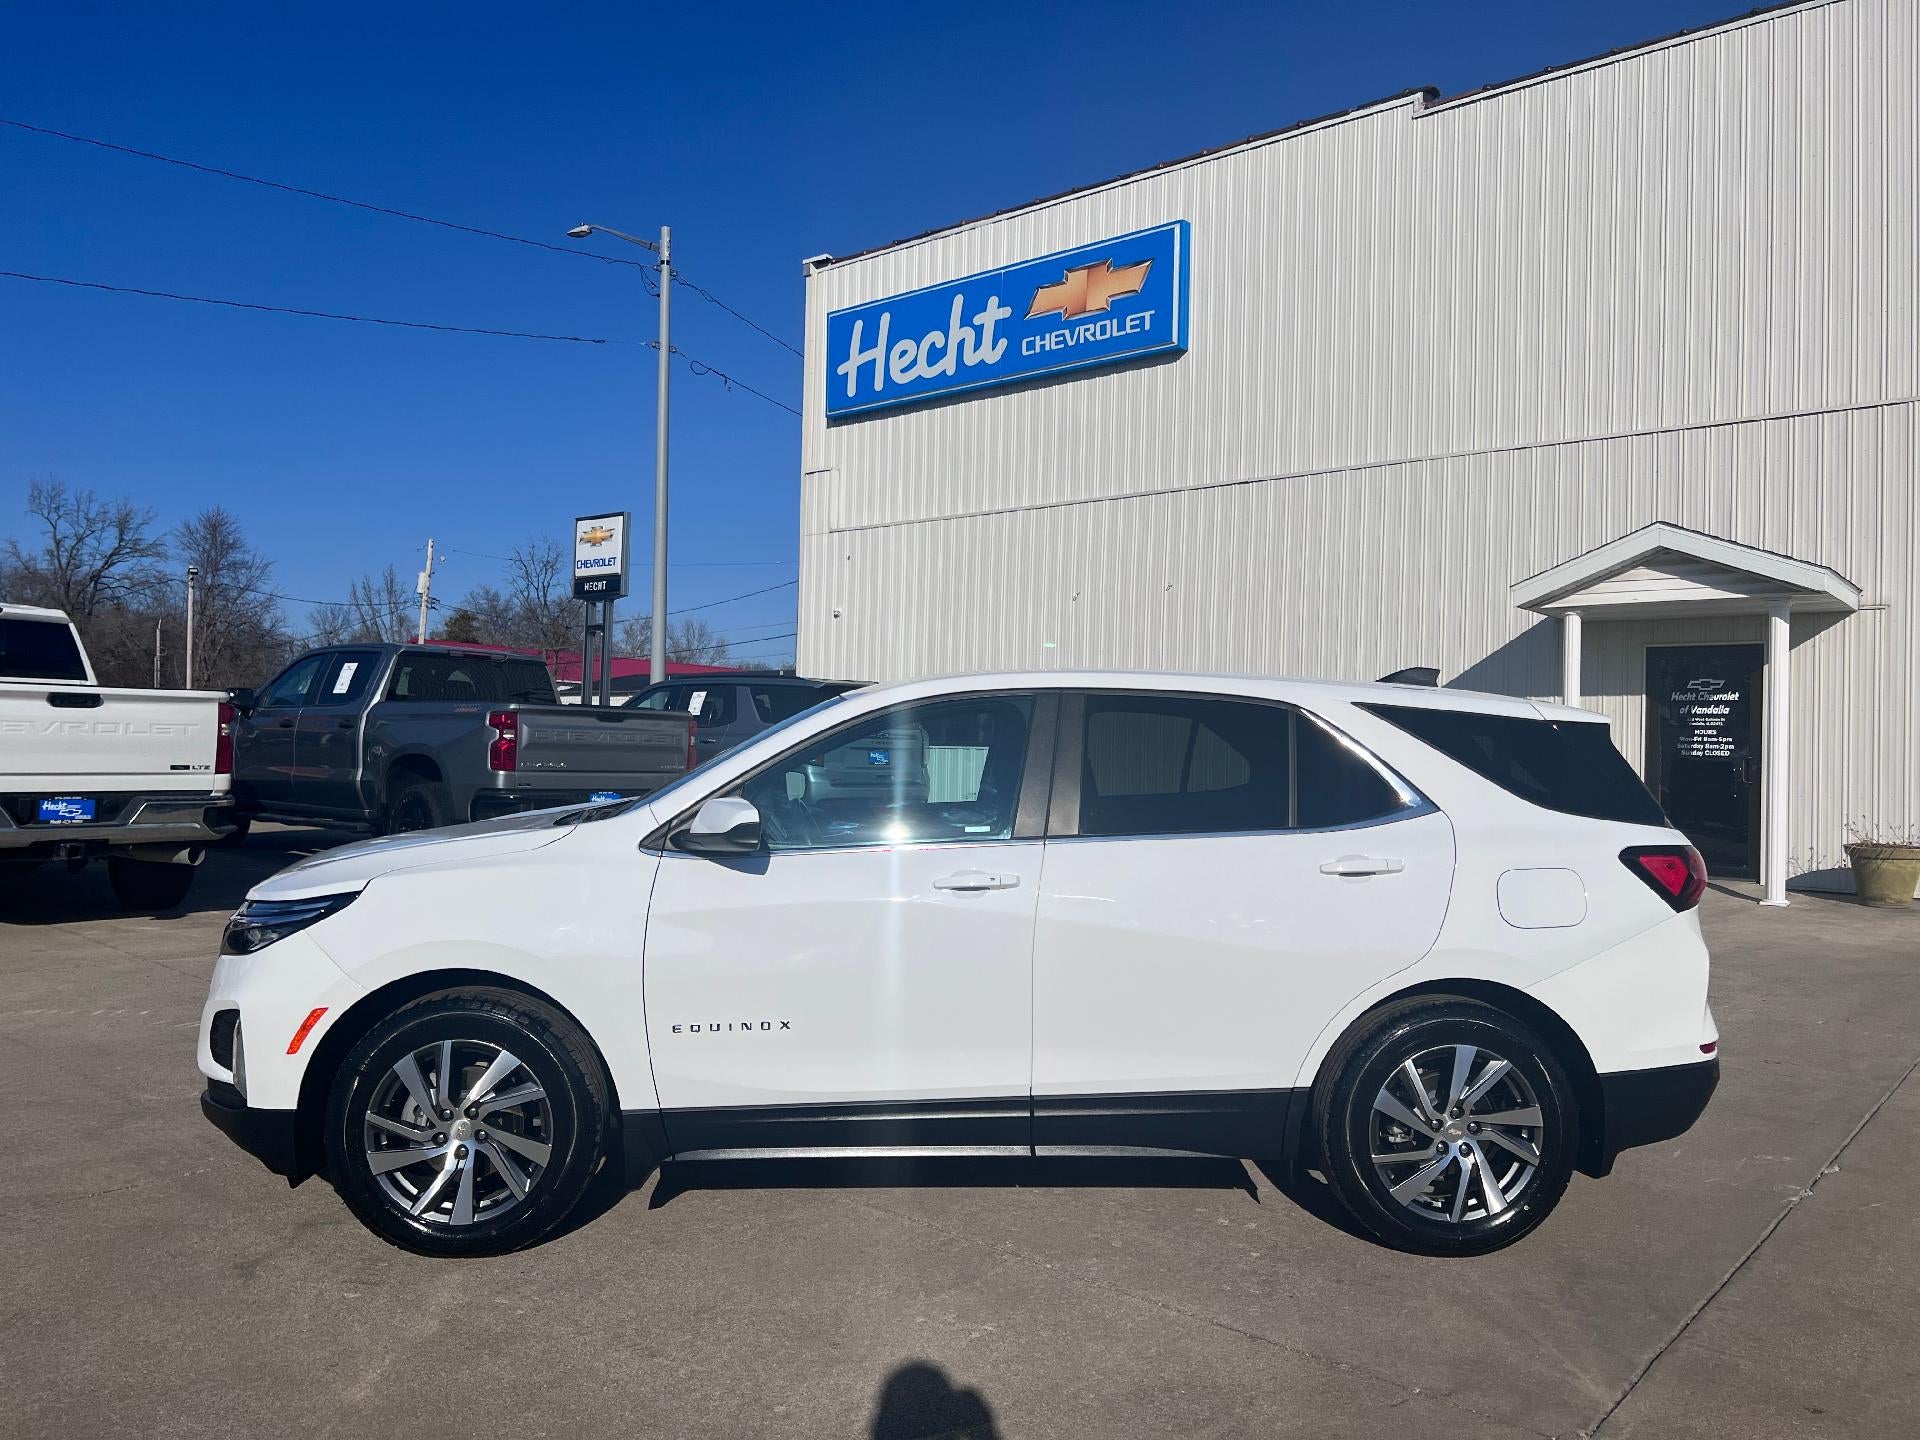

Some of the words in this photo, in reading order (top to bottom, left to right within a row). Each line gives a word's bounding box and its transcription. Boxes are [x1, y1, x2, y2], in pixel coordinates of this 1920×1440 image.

[1021, 310, 1156, 356] CHEVROLET
[837, 294, 1012, 398] Hecht
[576, 557, 617, 570] CHEVROLET
[584, 581, 607, 591] HECHT
[1671, 691, 1697, 701] Hecht
[1698, 691, 1740, 701] Chevrolet
[1680, 705, 1690, 714] of
[1691, 704, 1730, 715] Vandalia
[535, 730, 682, 745] CHEVROLET
[1677, 743, 1704, 751] Saturday
[672, 1020, 791, 1034] EQUINOX
